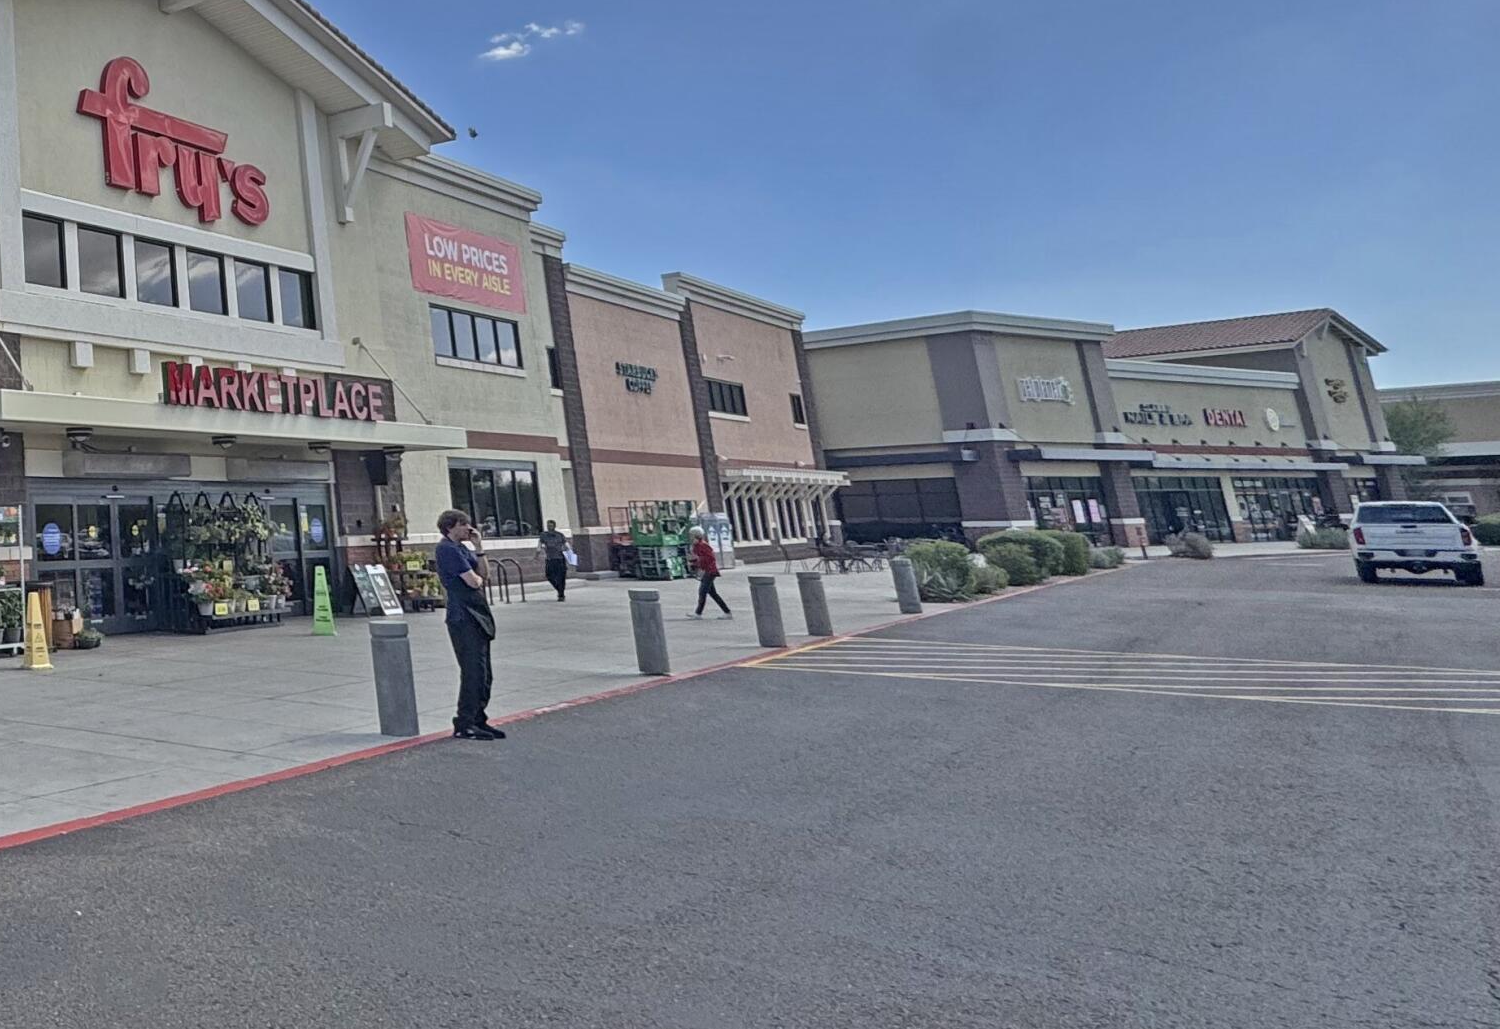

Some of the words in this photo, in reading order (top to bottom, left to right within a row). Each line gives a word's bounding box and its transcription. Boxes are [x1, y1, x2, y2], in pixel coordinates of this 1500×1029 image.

[76, 56, 270, 226] fry's
[425, 232, 458, 262] LOW
[461, 243, 509, 275] PRICES
[427, 258, 443, 278] IN
[443, 262, 479, 287] EVERY
[482, 273, 513, 296] AISLE
[162, 361, 386, 422] MARKETPLACE
